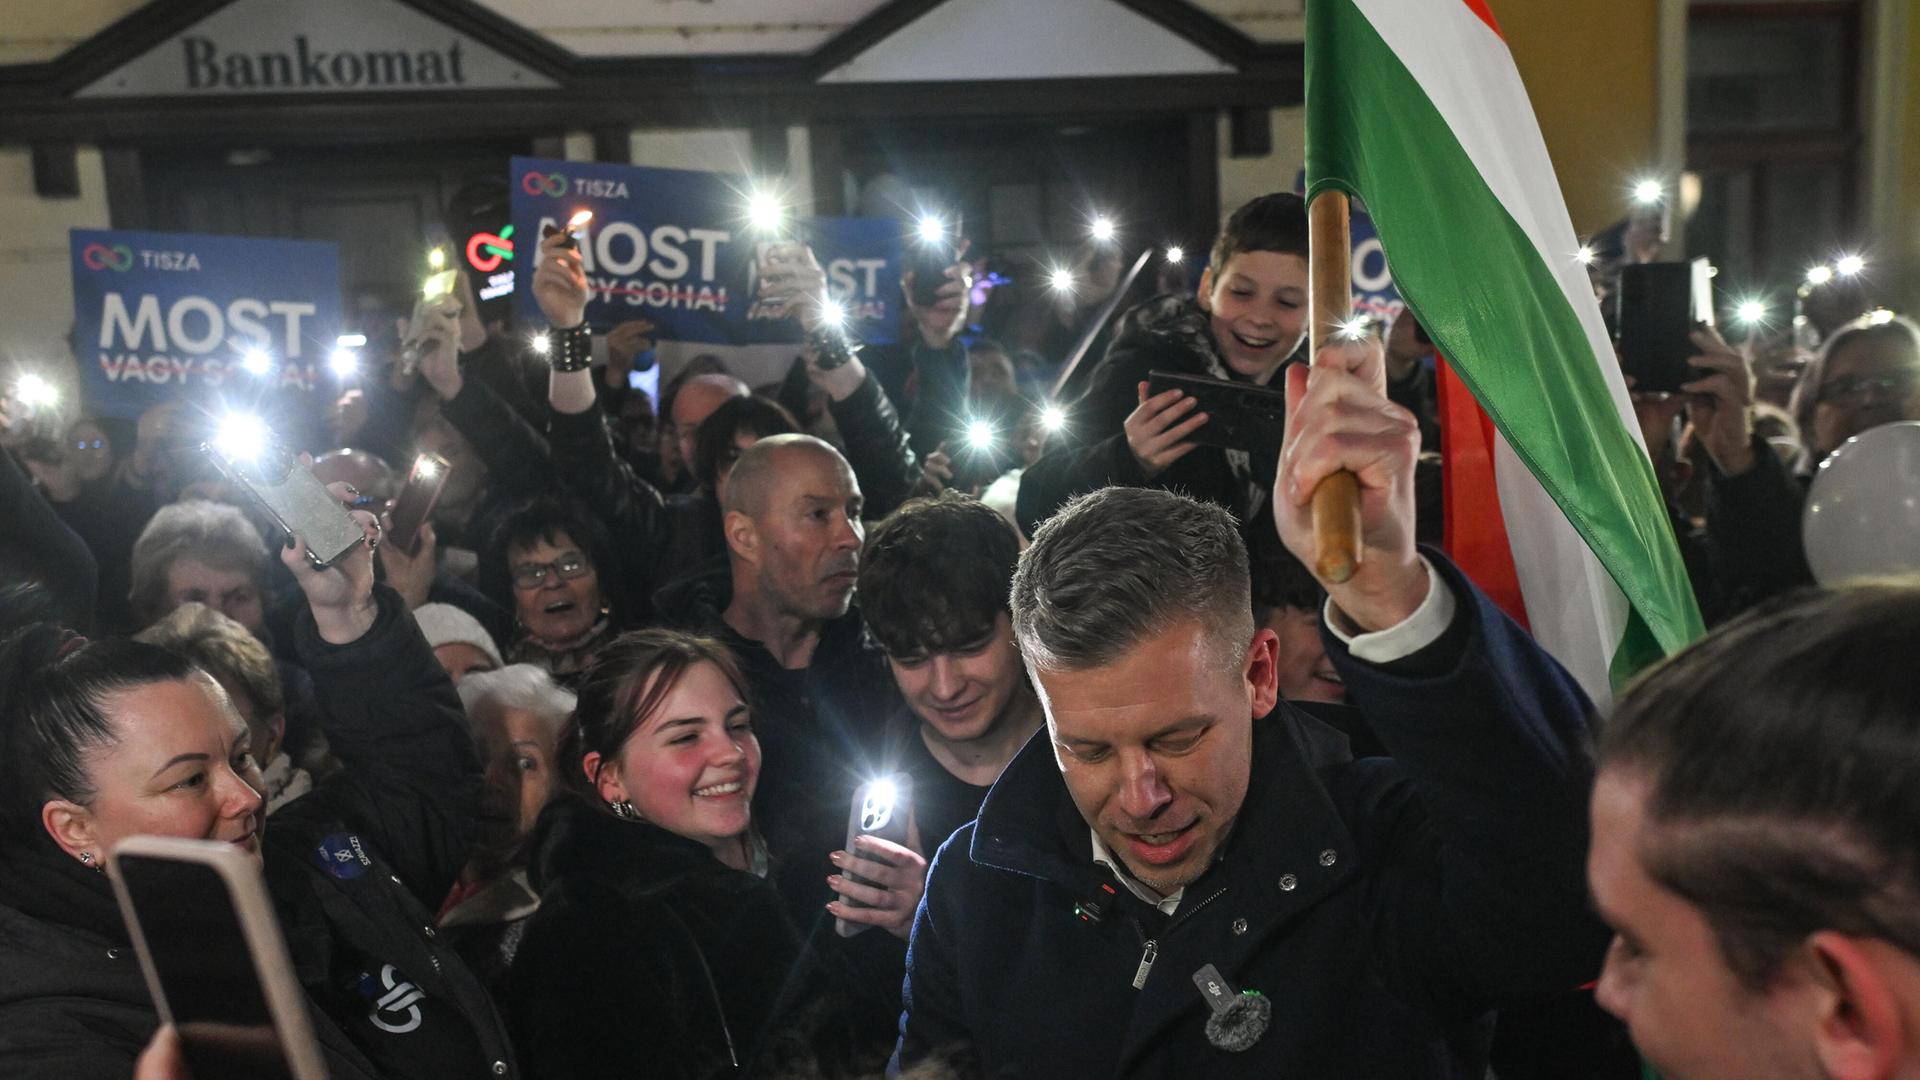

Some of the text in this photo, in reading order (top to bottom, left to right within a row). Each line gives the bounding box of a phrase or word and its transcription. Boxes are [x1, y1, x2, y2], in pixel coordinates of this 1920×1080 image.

[183, 36, 466, 88] Bankomat
[574, 178, 629, 199] TISZA
[141, 251, 202, 271] TISZA
[625, 279, 728, 313] SOHA!
[100, 292, 316, 358] MOST
[100, 352, 194, 385] VAGY
